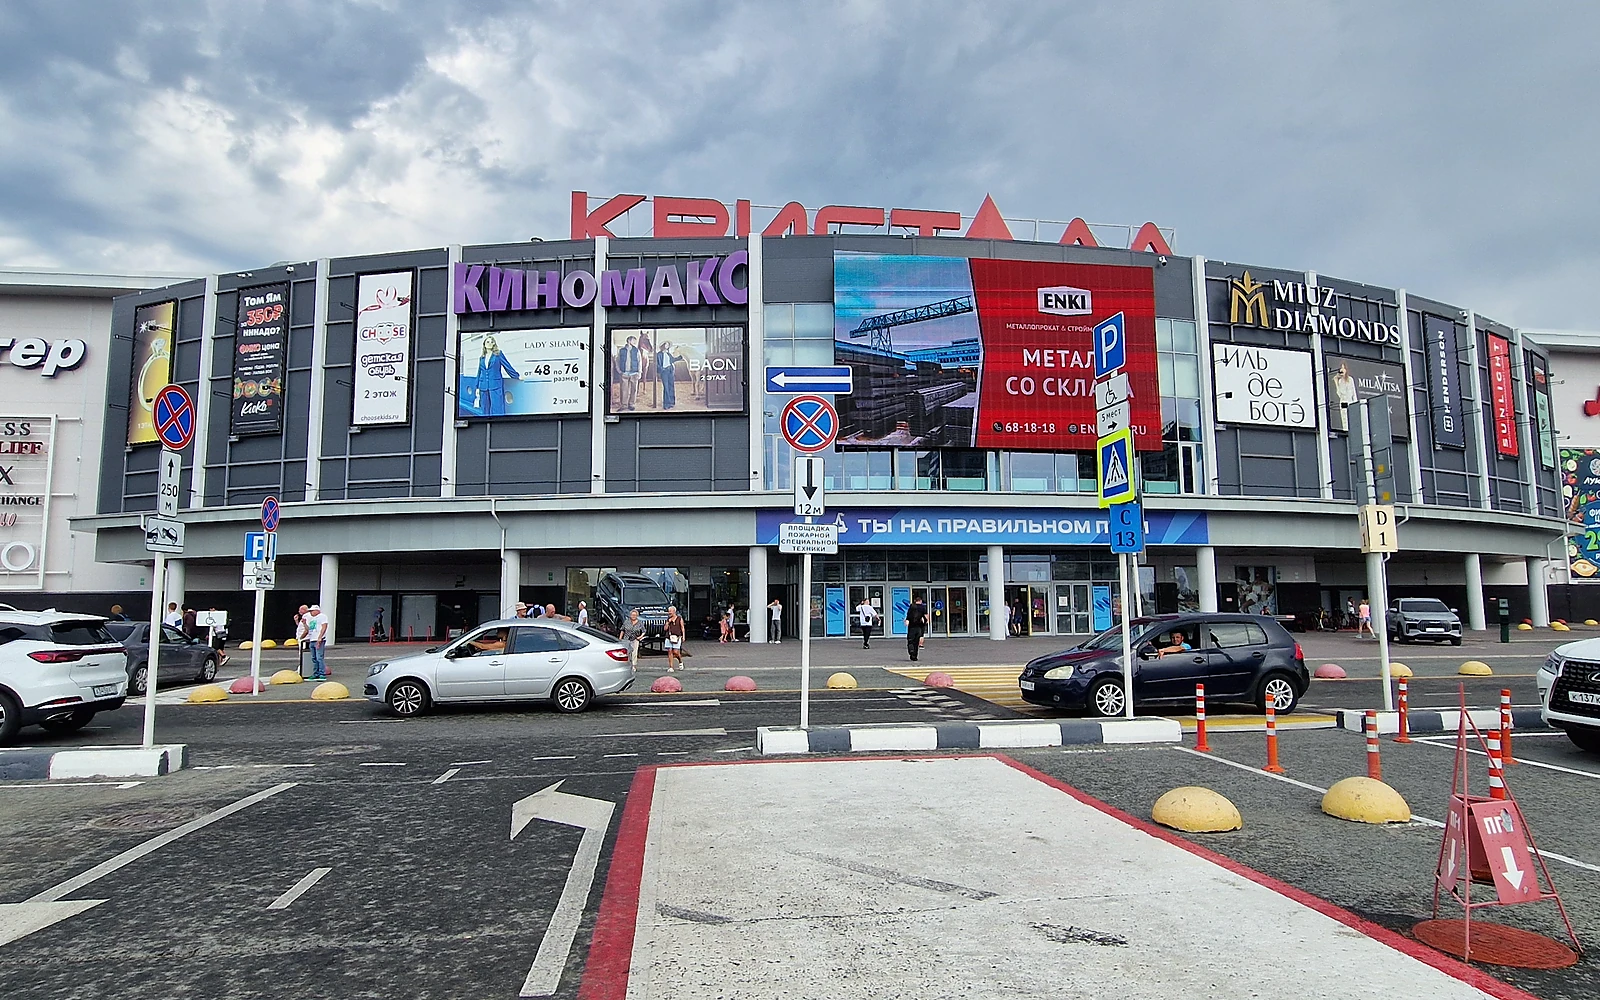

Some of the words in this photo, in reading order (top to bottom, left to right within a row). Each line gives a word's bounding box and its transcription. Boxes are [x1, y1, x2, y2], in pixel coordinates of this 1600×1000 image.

[454, 250, 748, 314] КИНОМАКС
[1043, 293, 1086, 310] ENKI
[1273, 279, 1337, 309] MIUZ
[1006, 323, 1060, 331] МЕТАЛЛОПРОКАТ
[1275, 308, 1401, 345] DIAMONDS
[524, 341, 547, 349] LADY
[549, 340, 579, 348] SHARM
[1101, 324, 1118, 370] P
[533, 364, 551, 376] 48
[564, 362, 579, 374] 76
[690, 358, 737, 371] BAON
[1438, 330, 1451, 414] HENDERSON
[1005, 376, 1036, 396] СО
[364, 390, 370, 399] 2
[373, 389, 397, 398] этаж
[553, 397, 558, 405] 2
[1493, 342, 1509, 448] SUNLIGHT
[361, 413, 399, 422] choosekids.ru
[1004, 423, 1056, 435] 68-18-18
[161, 483, 178, 497] 250
[0, 496, 43, 506] HANGE
[1376, 510, 1388, 526] D
[857, 519, 893, 534] ТЫ
[900, 519, 934, 534] НА
[938, 519, 1091, 535] ПРАВИЛЬНОМ
[781, 538, 837, 546] СПЕЦИАЛЬНОЙ
[1115, 531, 1136, 547] 13
[1378, 531, 1388, 546] 1
[1585, 531, 1600, 551] 2
